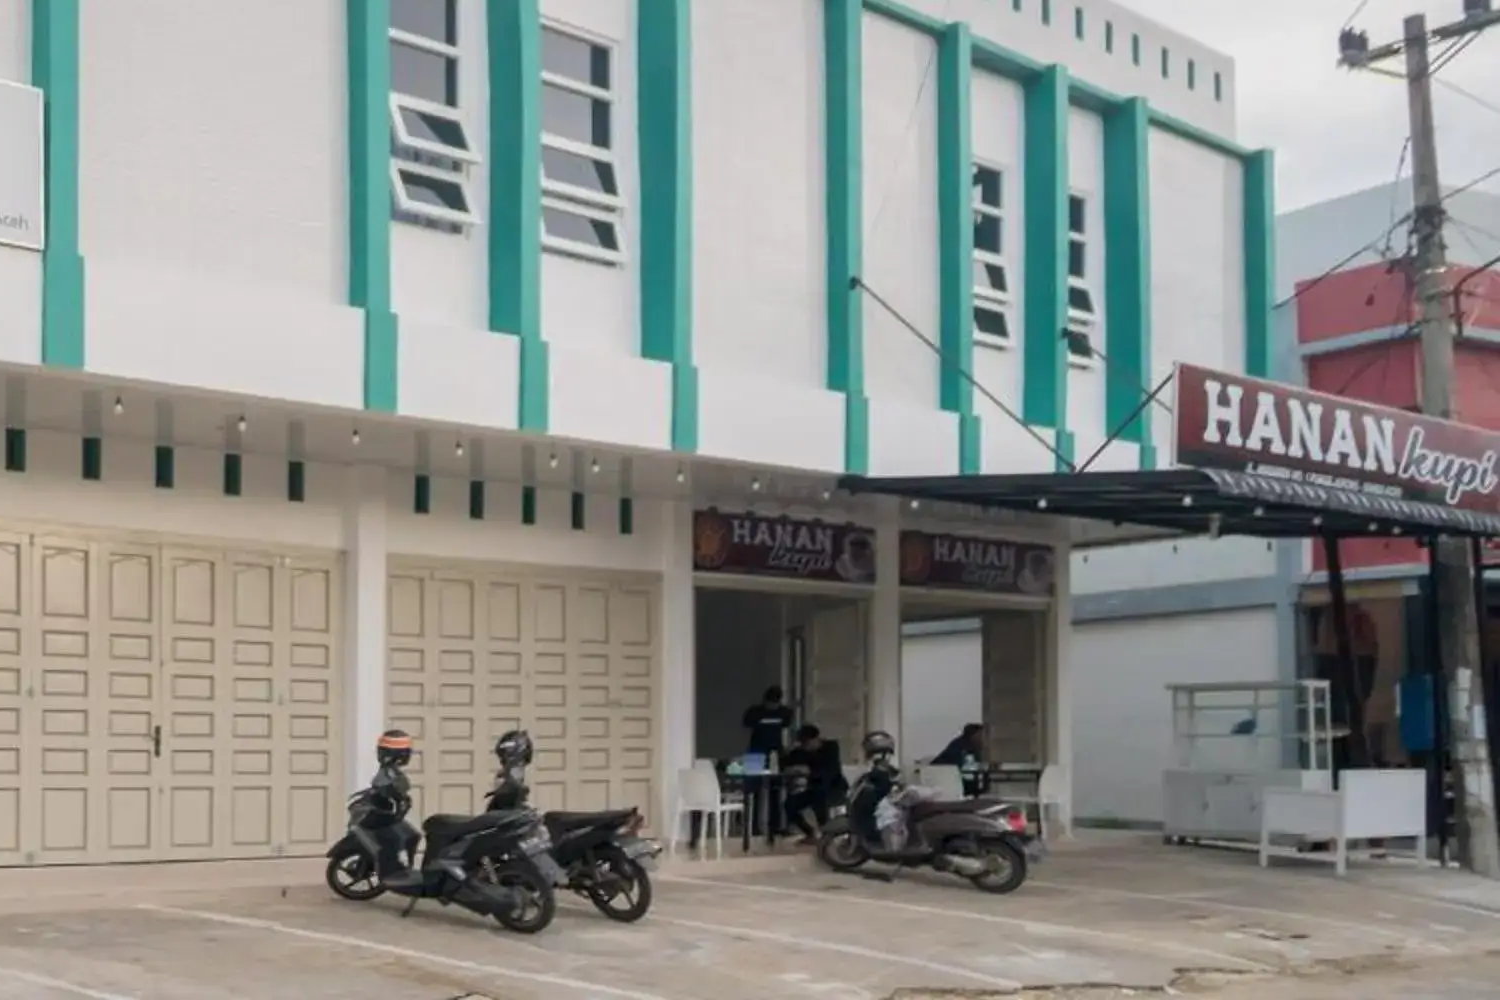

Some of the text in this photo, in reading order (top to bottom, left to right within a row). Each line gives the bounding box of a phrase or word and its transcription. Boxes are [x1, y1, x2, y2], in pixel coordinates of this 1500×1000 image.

[1203, 379, 1396, 476] HANAN
[1399, 425, 1499, 505] kupi
[730, 518, 834, 552] HANAN
[933, 536, 1017, 567] HANAN
